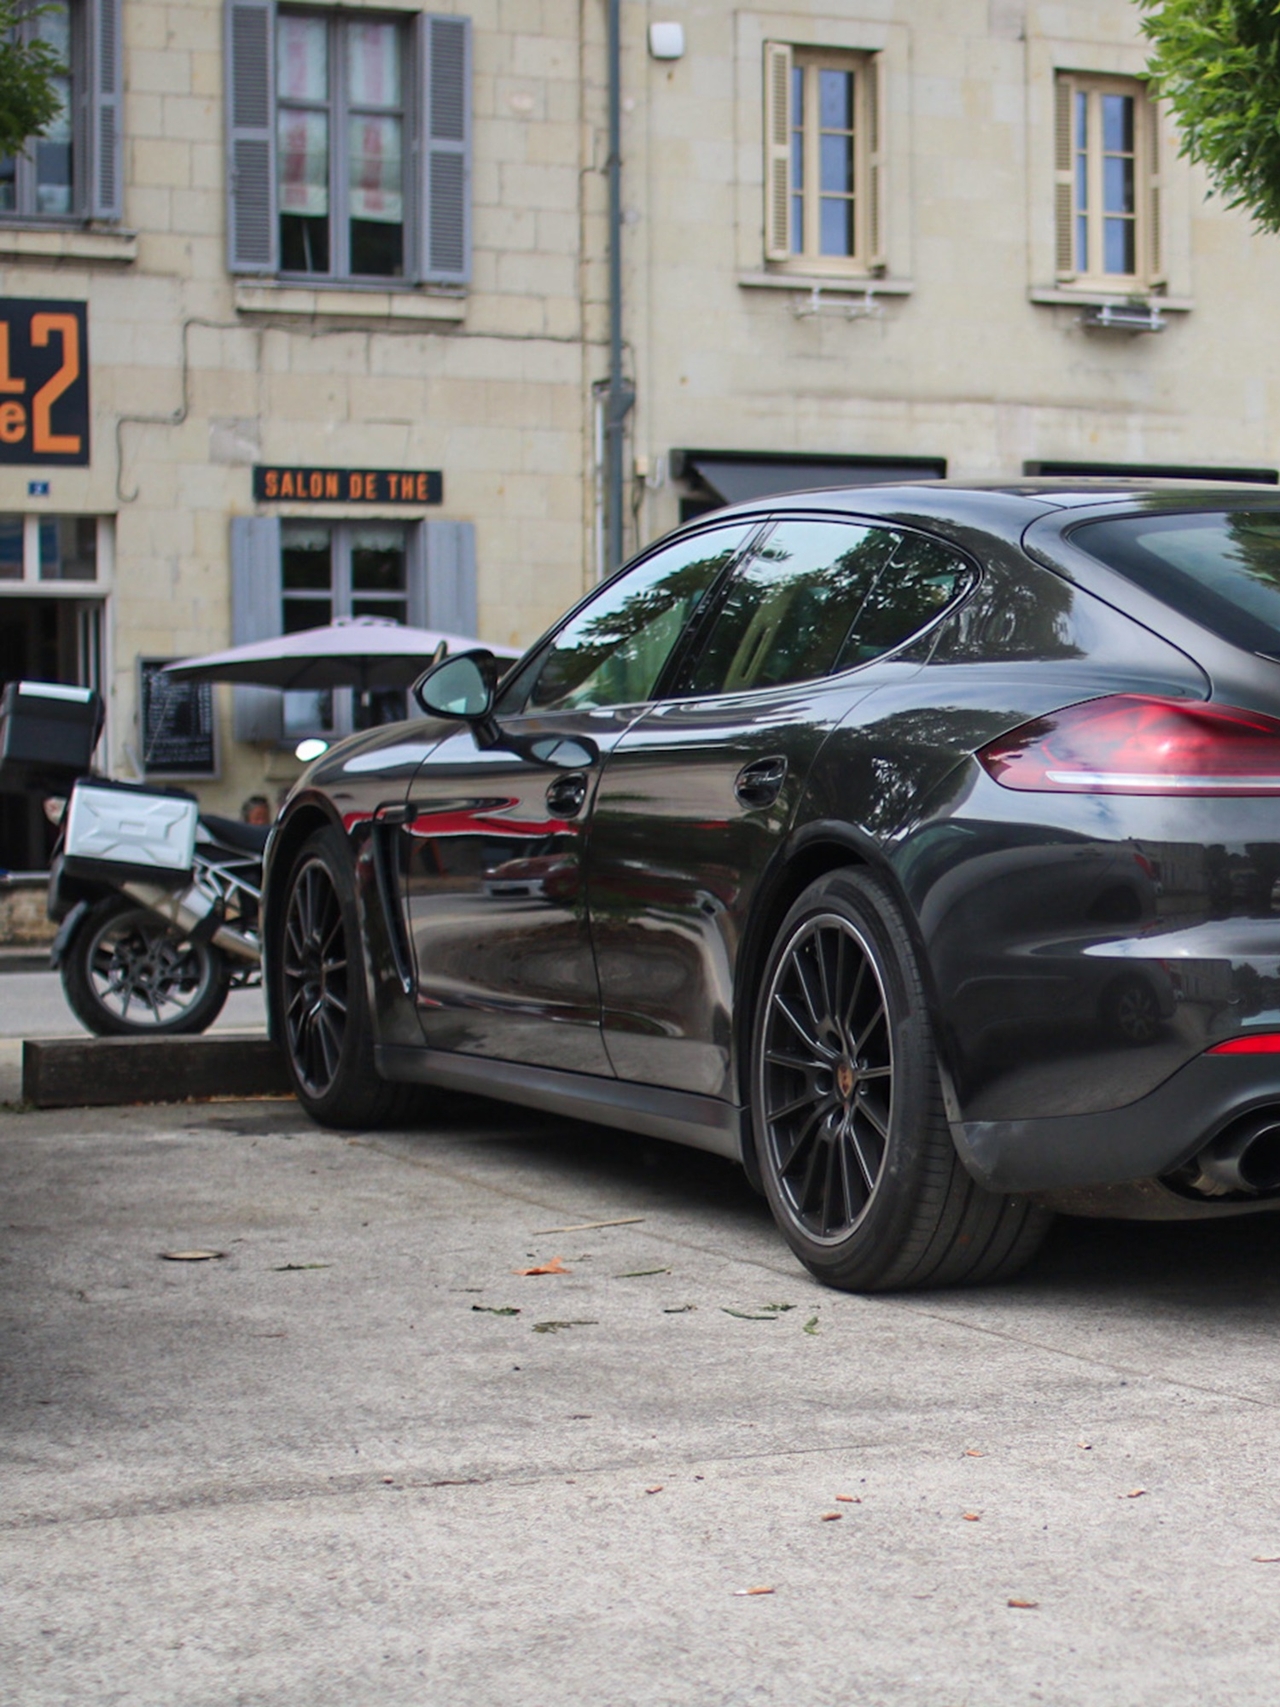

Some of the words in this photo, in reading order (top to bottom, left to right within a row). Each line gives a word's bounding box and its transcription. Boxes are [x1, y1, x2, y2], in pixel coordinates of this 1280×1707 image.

[30, 312, 81, 454] 2
[264, 470, 339, 498] SALON
[349, 472, 378, 499] DE
